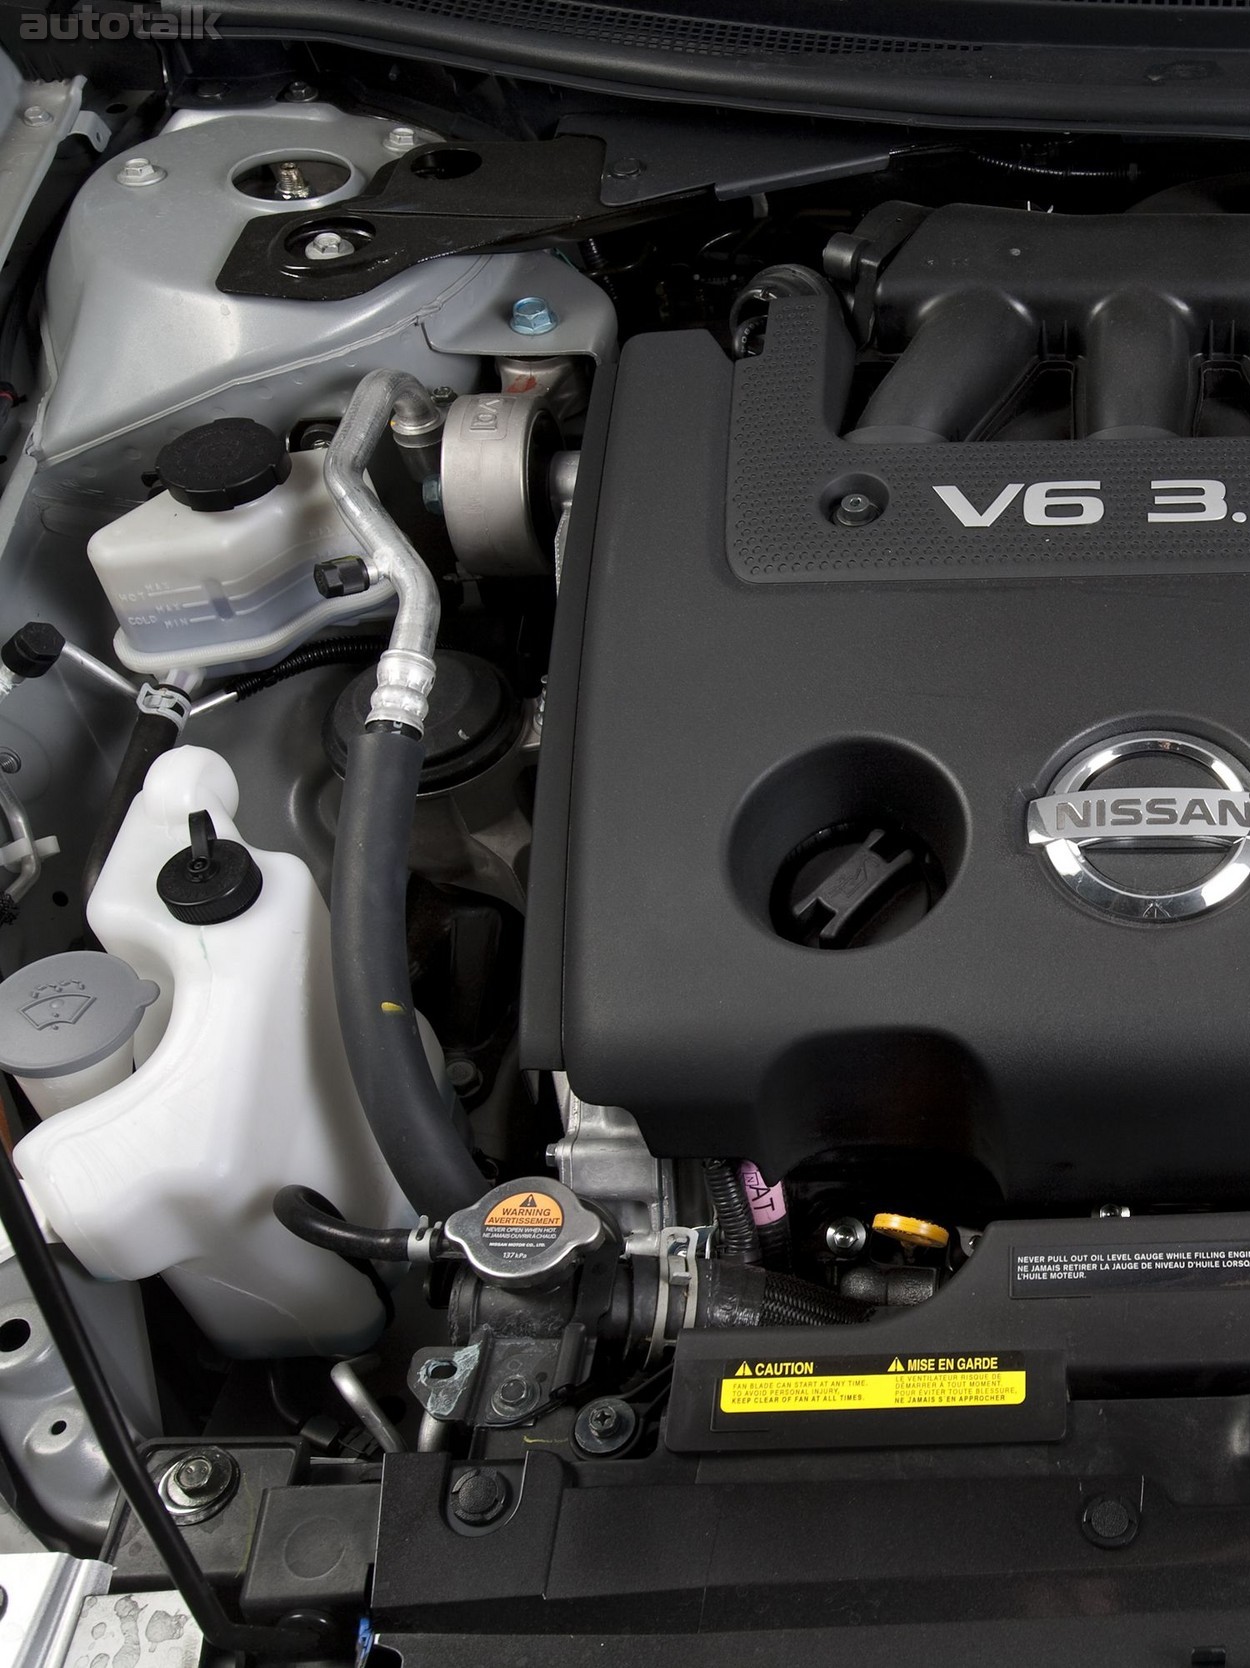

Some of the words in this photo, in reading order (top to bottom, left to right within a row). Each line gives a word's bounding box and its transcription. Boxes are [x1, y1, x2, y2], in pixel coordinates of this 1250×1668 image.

[932, 481, 1104, 527] V6
[502, 1208, 551, 1216] WARNING
[1166, 1252, 1192, 1260] WHILE
[1031, 1264, 1060, 1272] JAMAIS
[1112, 1262, 1139, 1270] JAUGE
[755, 1362, 814, 1376] CAUTION
[908, 1359, 935, 1371] MISE
[938, 1358, 954, 1370] EN
[957, 1357, 998, 1370] GARDE
